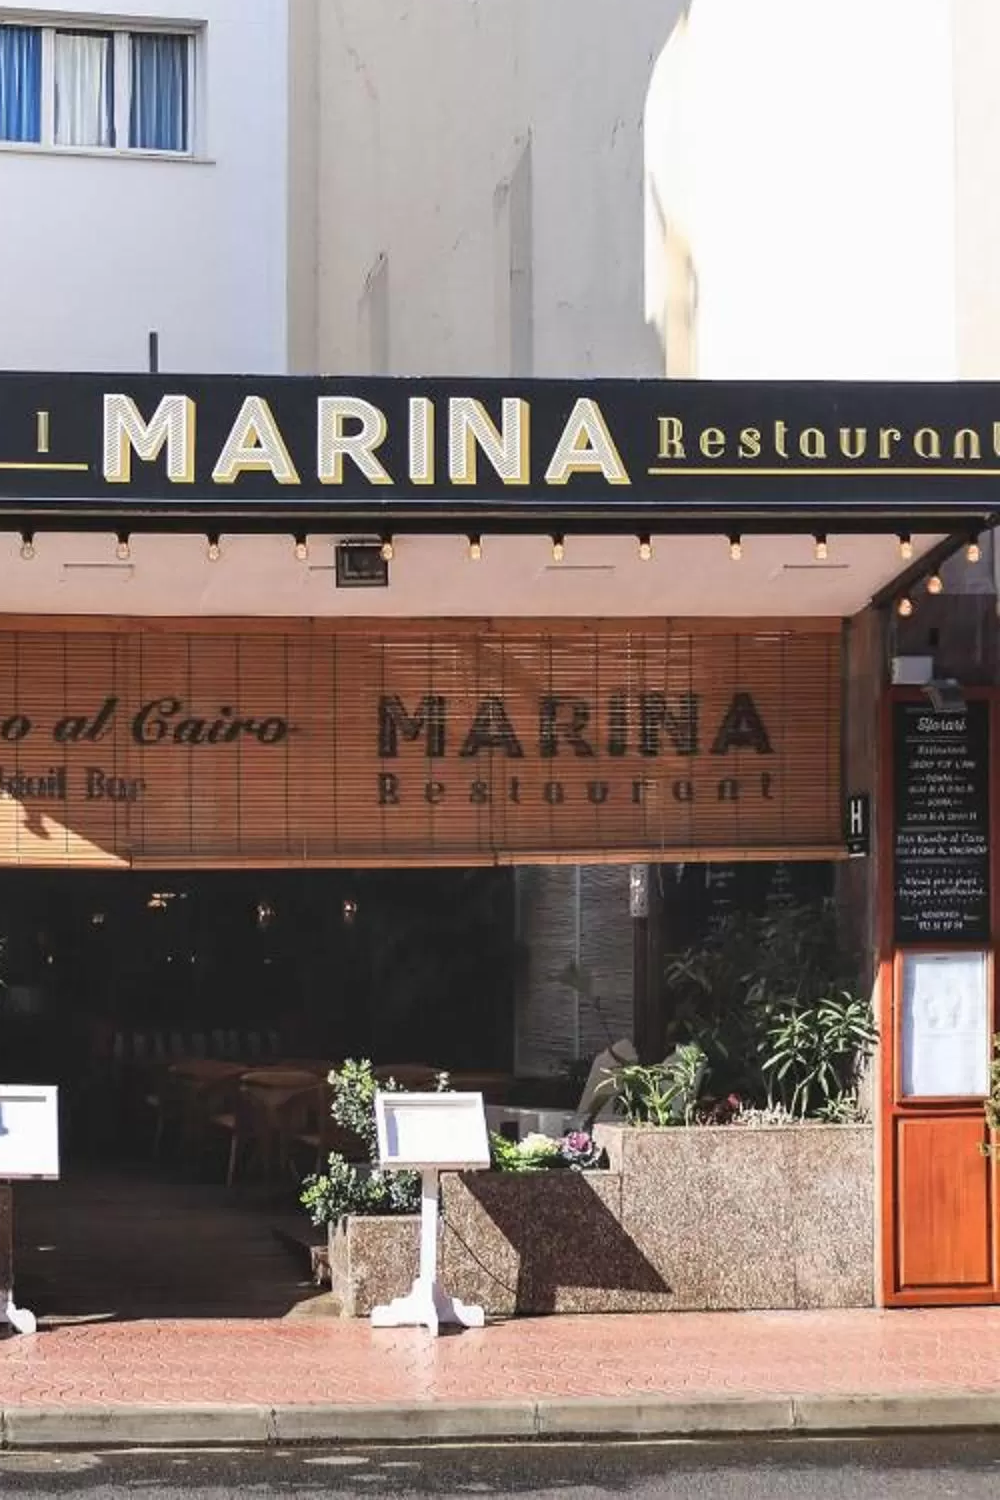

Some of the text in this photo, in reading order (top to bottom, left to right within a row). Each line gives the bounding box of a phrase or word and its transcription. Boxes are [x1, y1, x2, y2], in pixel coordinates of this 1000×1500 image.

[102, 393, 632, 484] MARINA
[53, 695, 118, 742] al
[132, 696, 298, 745] Cairo
[376, 691, 776, 758] MARINA
[86, 766, 146, 800] Bar
[377, 772, 775, 805] Restaurant
[851, 799, 862, 834] H
